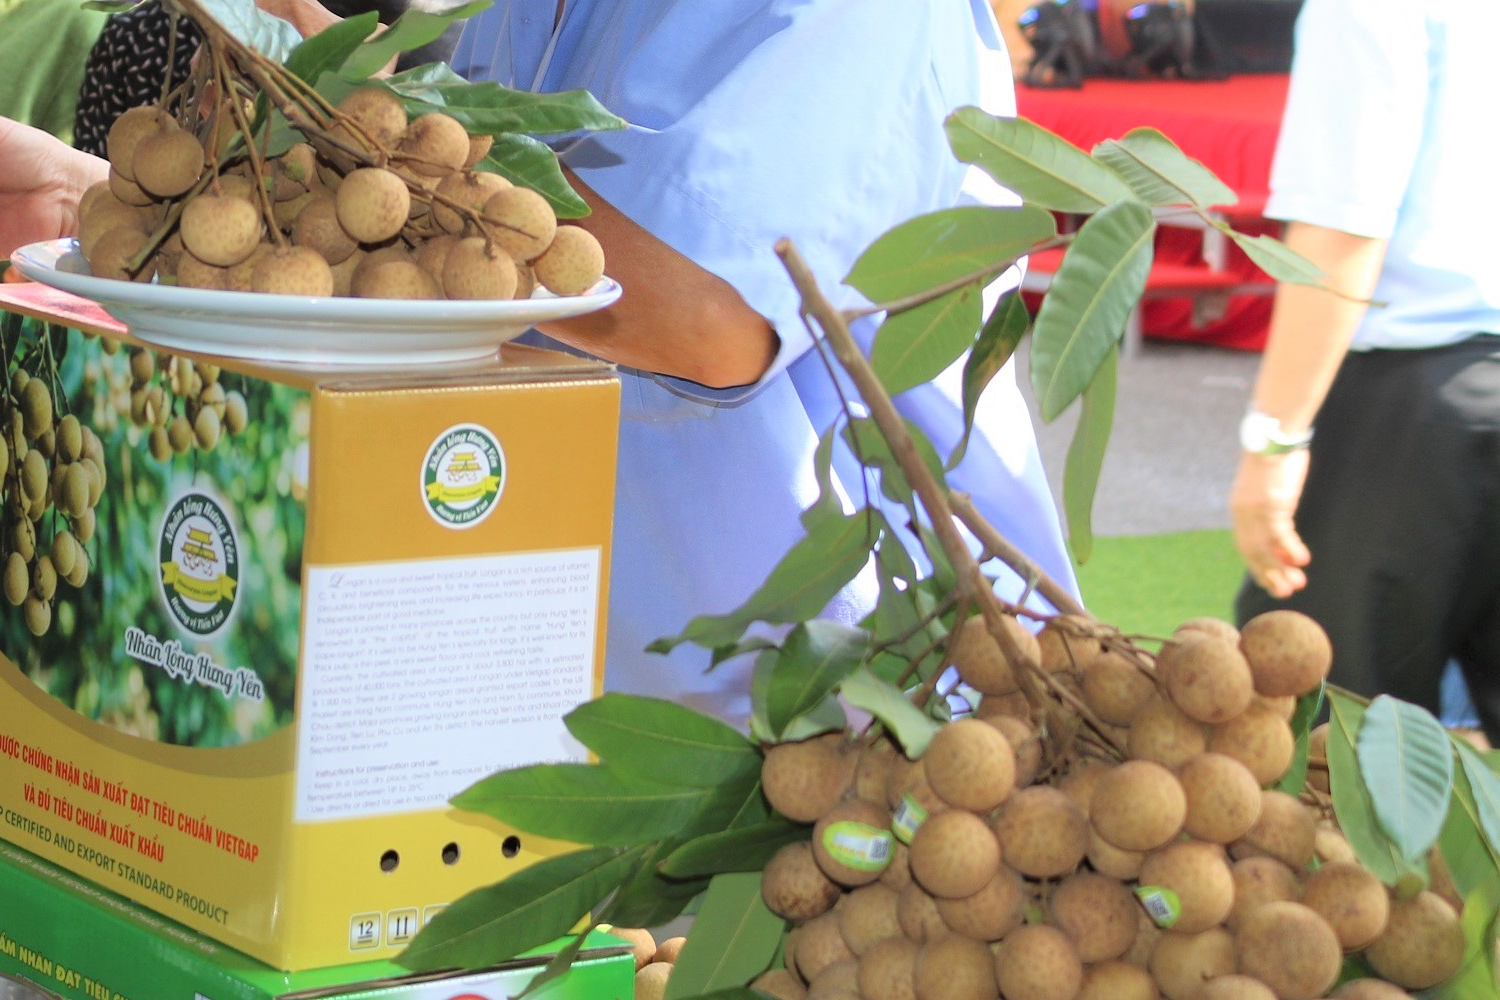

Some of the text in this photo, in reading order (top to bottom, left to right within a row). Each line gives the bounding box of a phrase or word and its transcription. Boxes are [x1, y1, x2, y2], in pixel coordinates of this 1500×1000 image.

[126, 629, 162, 661] Nhãn
[236, 670, 262, 700] Yên
[22, 745, 52, 774] CHỨNG
[56, 758, 80, 786] NHẬN
[82, 769, 100, 795] SẢN
[102, 781, 128, 807] XUẤT
[130, 792, 150, 818] ĐẠT
[153, 801, 174, 828] TIÊU
[178, 814, 213, 844] CHUẨN
[216, 829, 260, 862] VIETGAP
[24, 782, 164, 863] VÀ ĐỦ TIÊU CHUẨN XUẤT KHẨU
[5, 810, 52, 842] CERTIFIED
[54, 833, 76, 854] AND
[77, 843, 116, 872] EXPORT
[118, 862, 174, 900] STANDARD
[176, 889, 229, 925] PRODUCT
[357, 922, 374, 934] 12
[55, 964, 82, 990] ĐẠT
